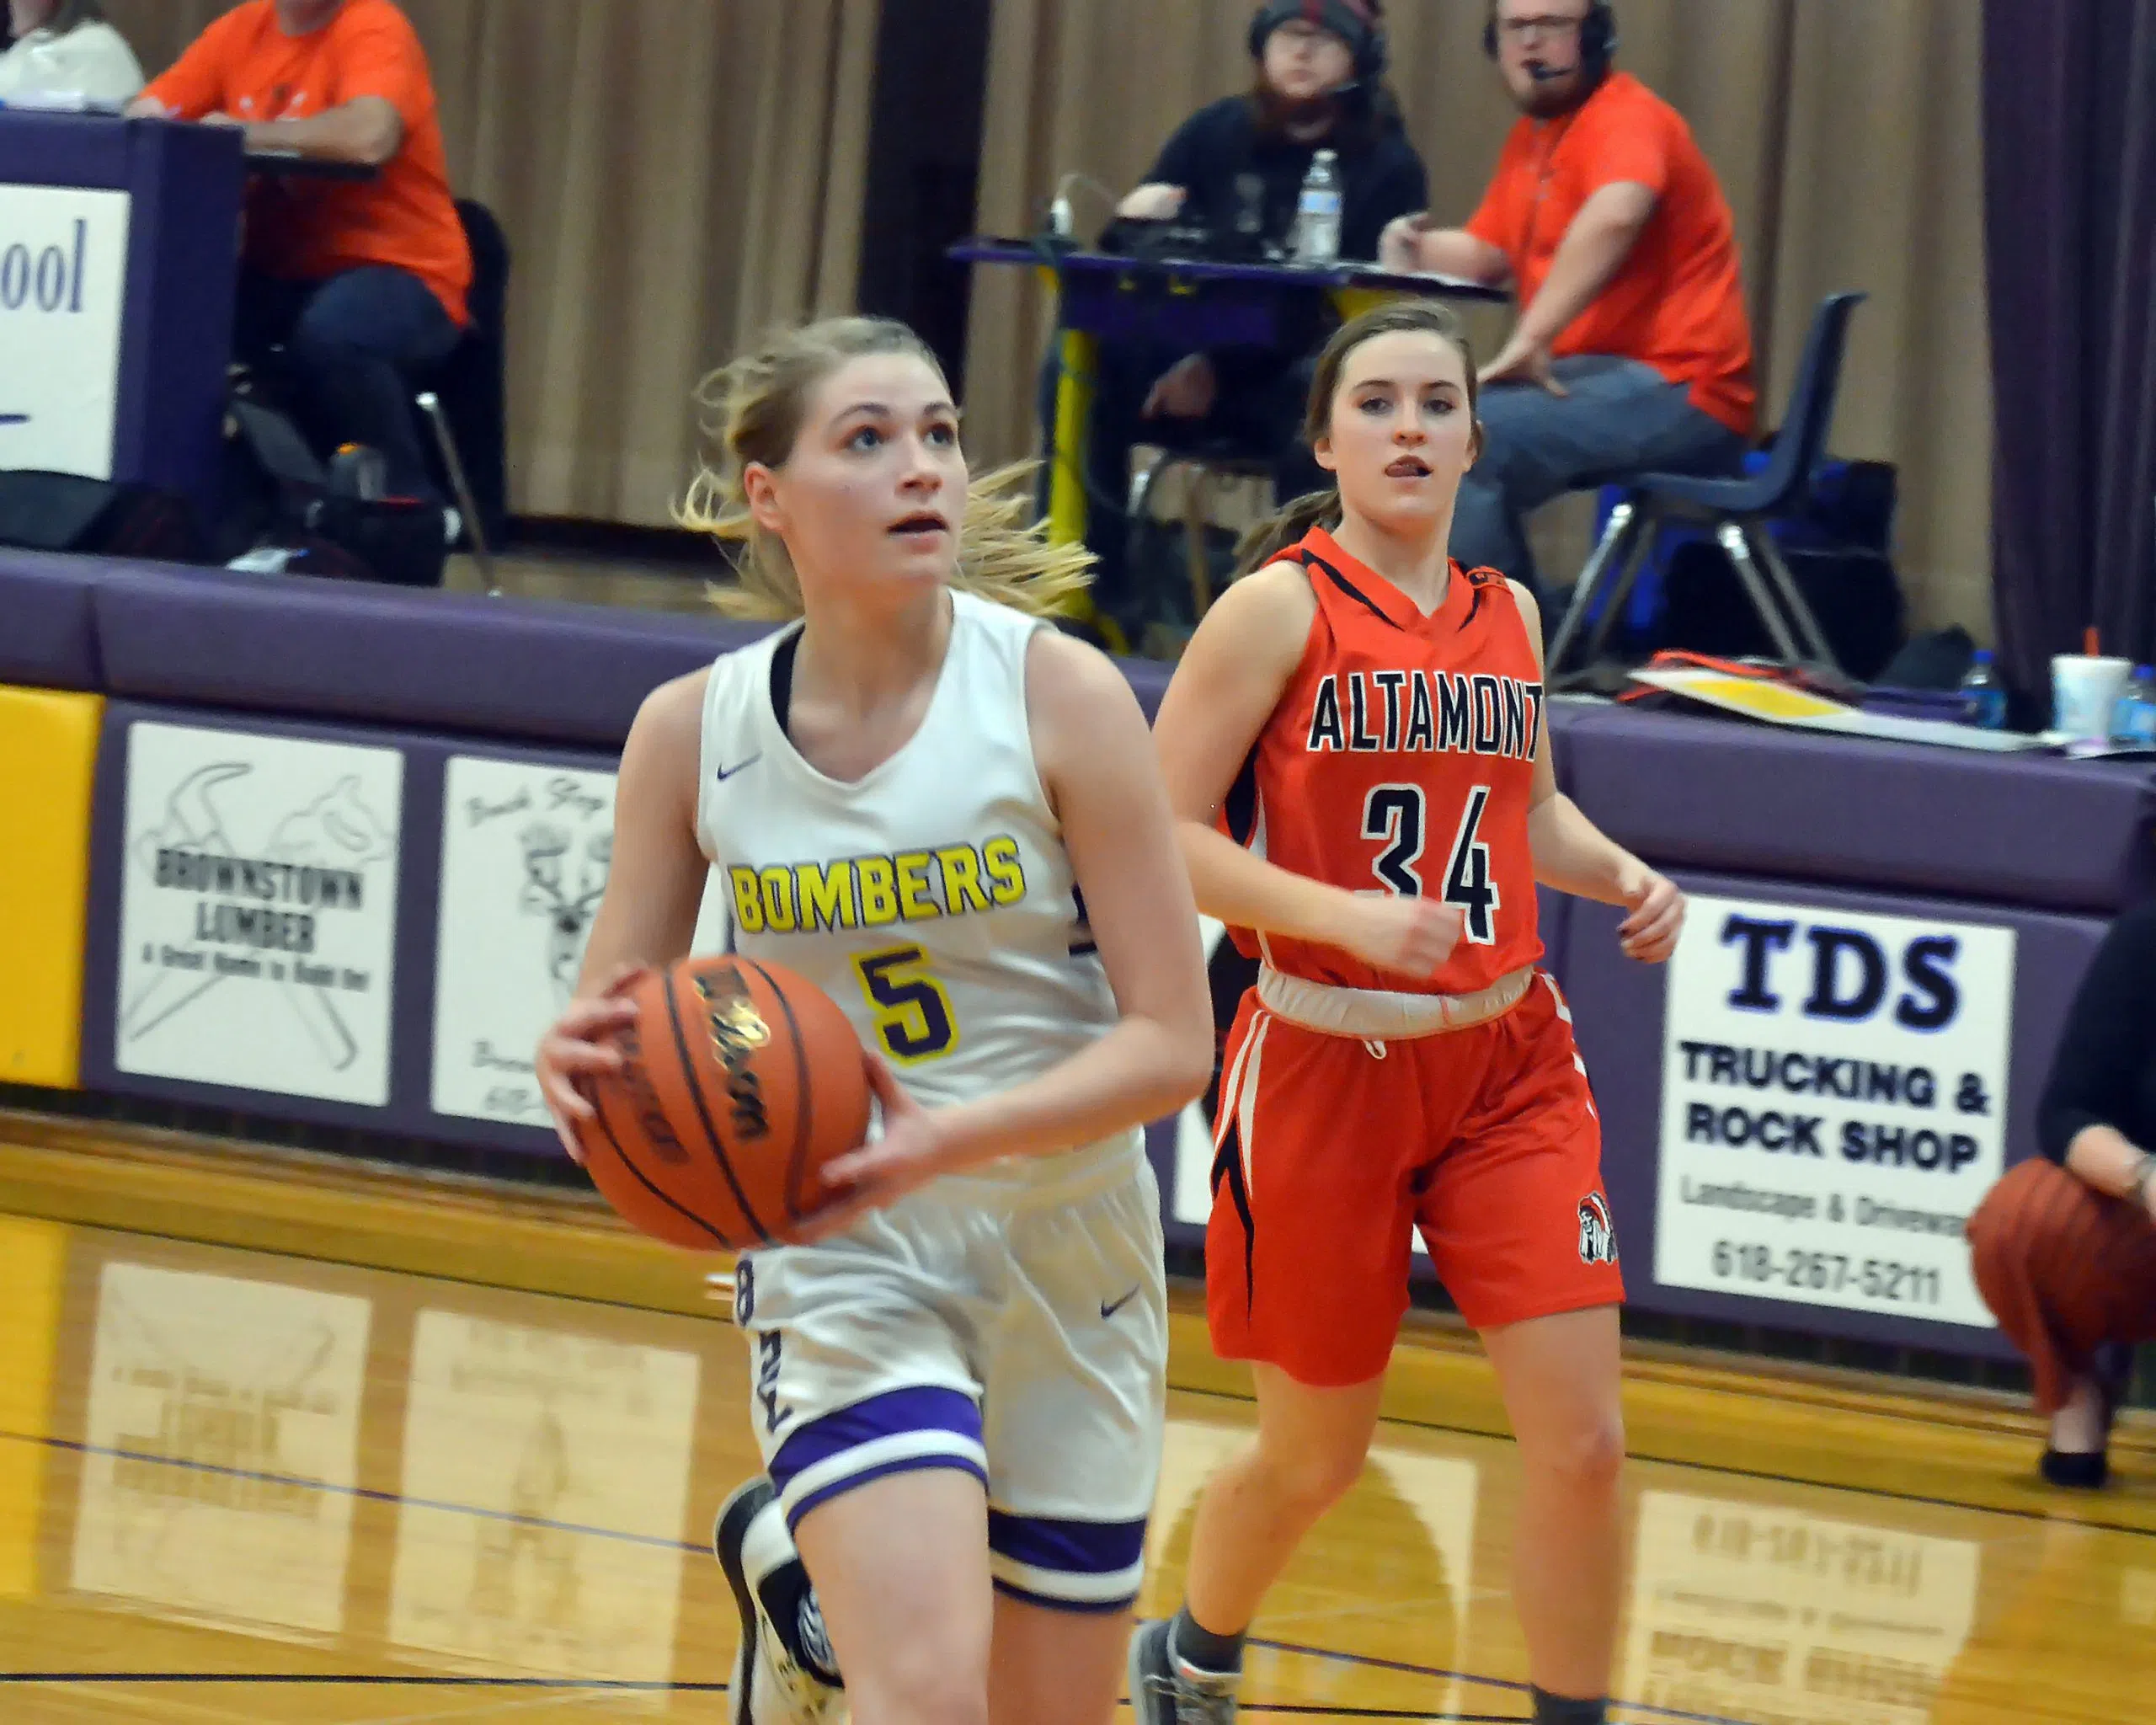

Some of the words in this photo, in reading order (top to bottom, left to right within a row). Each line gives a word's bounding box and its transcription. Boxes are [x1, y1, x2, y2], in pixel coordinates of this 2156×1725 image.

[1306, 670, 1542, 762] ALTAMONT
[155, 848, 363, 910] BROWNSTOWN
[728, 833, 1027, 935] BOMBERS
[1355, 782, 1500, 945] 34
[195, 901, 315, 953] LUMBER
[849, 940, 958, 1065] 5
[1721, 912, 1961, 1033] TDS
[1679, 1040, 1938, 1109] TRUCKING
[1955, 1074, 1990, 1115] &
[1686, 1103, 1825, 1156] ROCK
[1841, 1121, 1978, 1173] SHOP
[1681, 1174, 1814, 1220] Landscape
[1711, 1241, 1940, 1305] 618-267-5211
